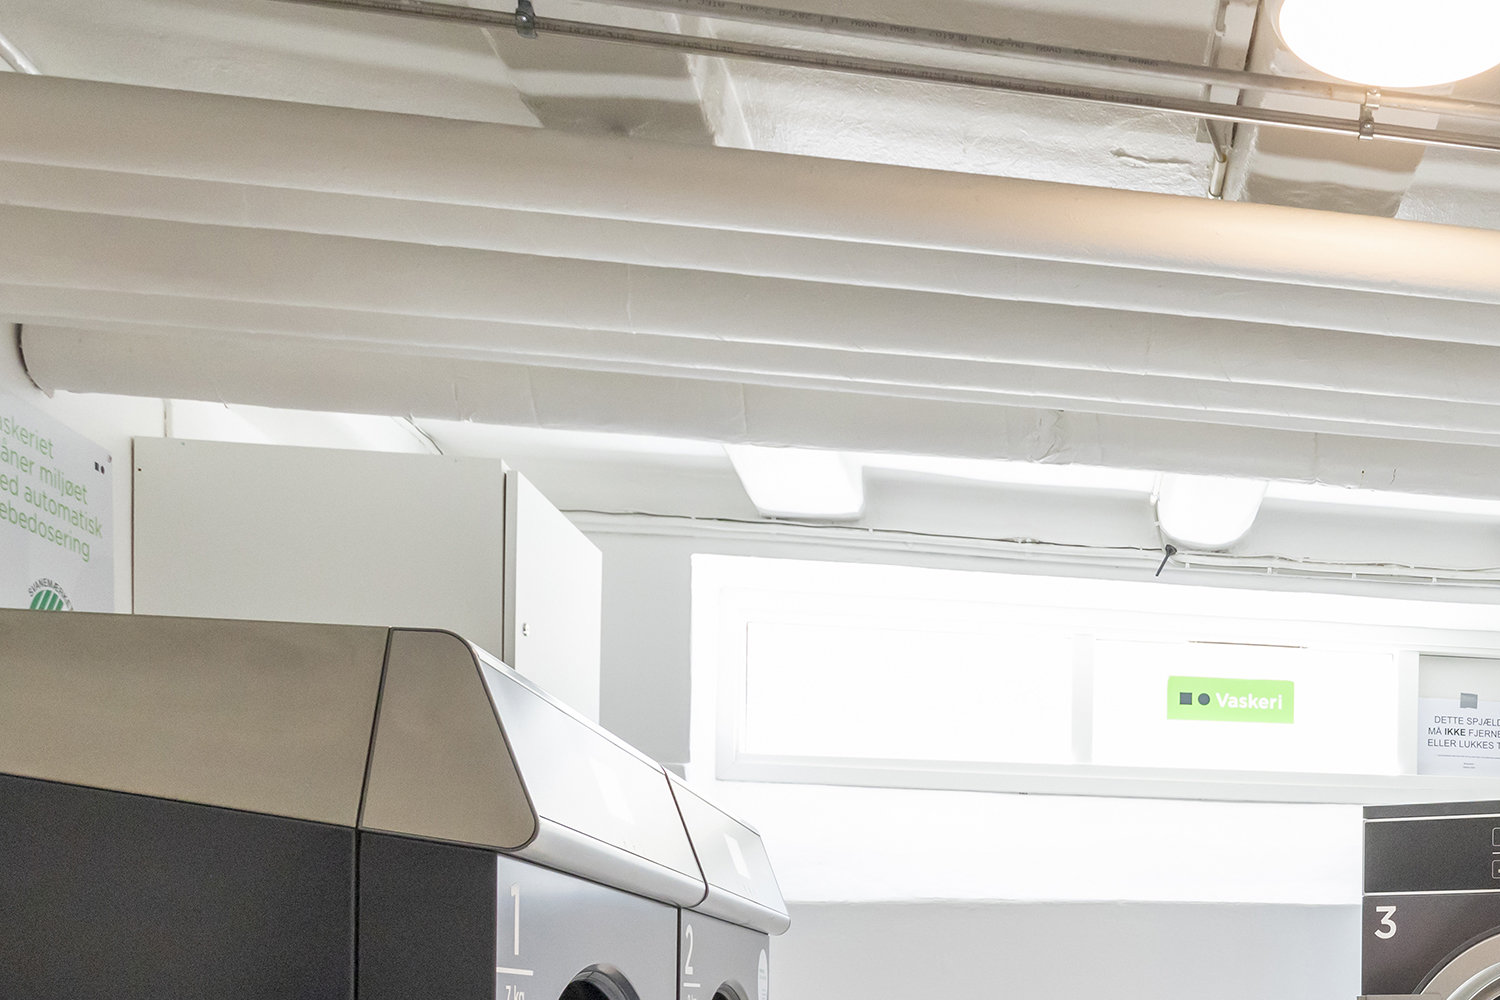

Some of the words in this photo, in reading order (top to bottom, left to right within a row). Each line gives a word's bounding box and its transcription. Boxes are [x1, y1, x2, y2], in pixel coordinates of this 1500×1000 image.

[0, 416, 53, 459] skeriet
[40, 465, 88, 505] miljøet
[24, 485, 103, 539] automatisk
[1215, 692, 1283, 710] Vaskeri
[1434, 715, 1464, 725] DETTE
[1444, 728, 1466, 737] IKKE
[1427, 739, 1457, 748] ELLER
[1459, 740, 1494, 750] LUKKES
[510, 884, 519, 956] 1
[1374, 905, 1397, 939] 3
[685, 924, 693, 975] 2
